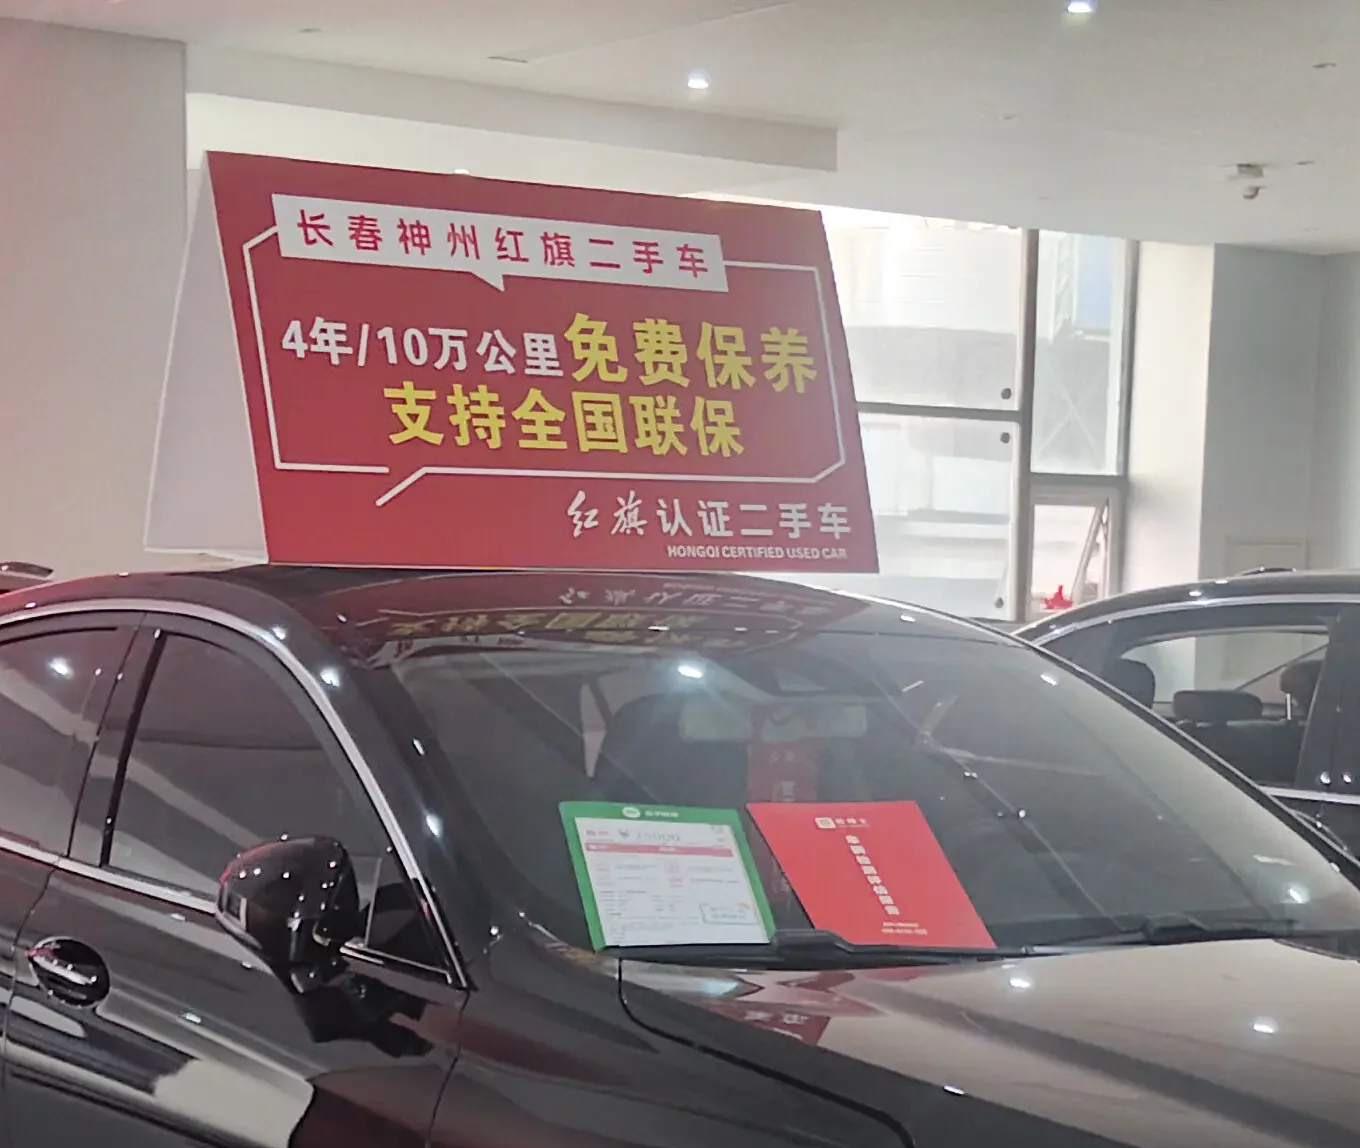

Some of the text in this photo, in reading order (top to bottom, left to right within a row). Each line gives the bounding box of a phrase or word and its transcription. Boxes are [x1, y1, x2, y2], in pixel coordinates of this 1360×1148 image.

[296, 209, 709, 278] 长春神州红旗二手车
[383, 381, 744, 457] 支持全国联保
[566, 489, 852, 541] 红旗认证二手车
[667, 545, 848, 559] HONGQI CERTIFIED USED CAR
